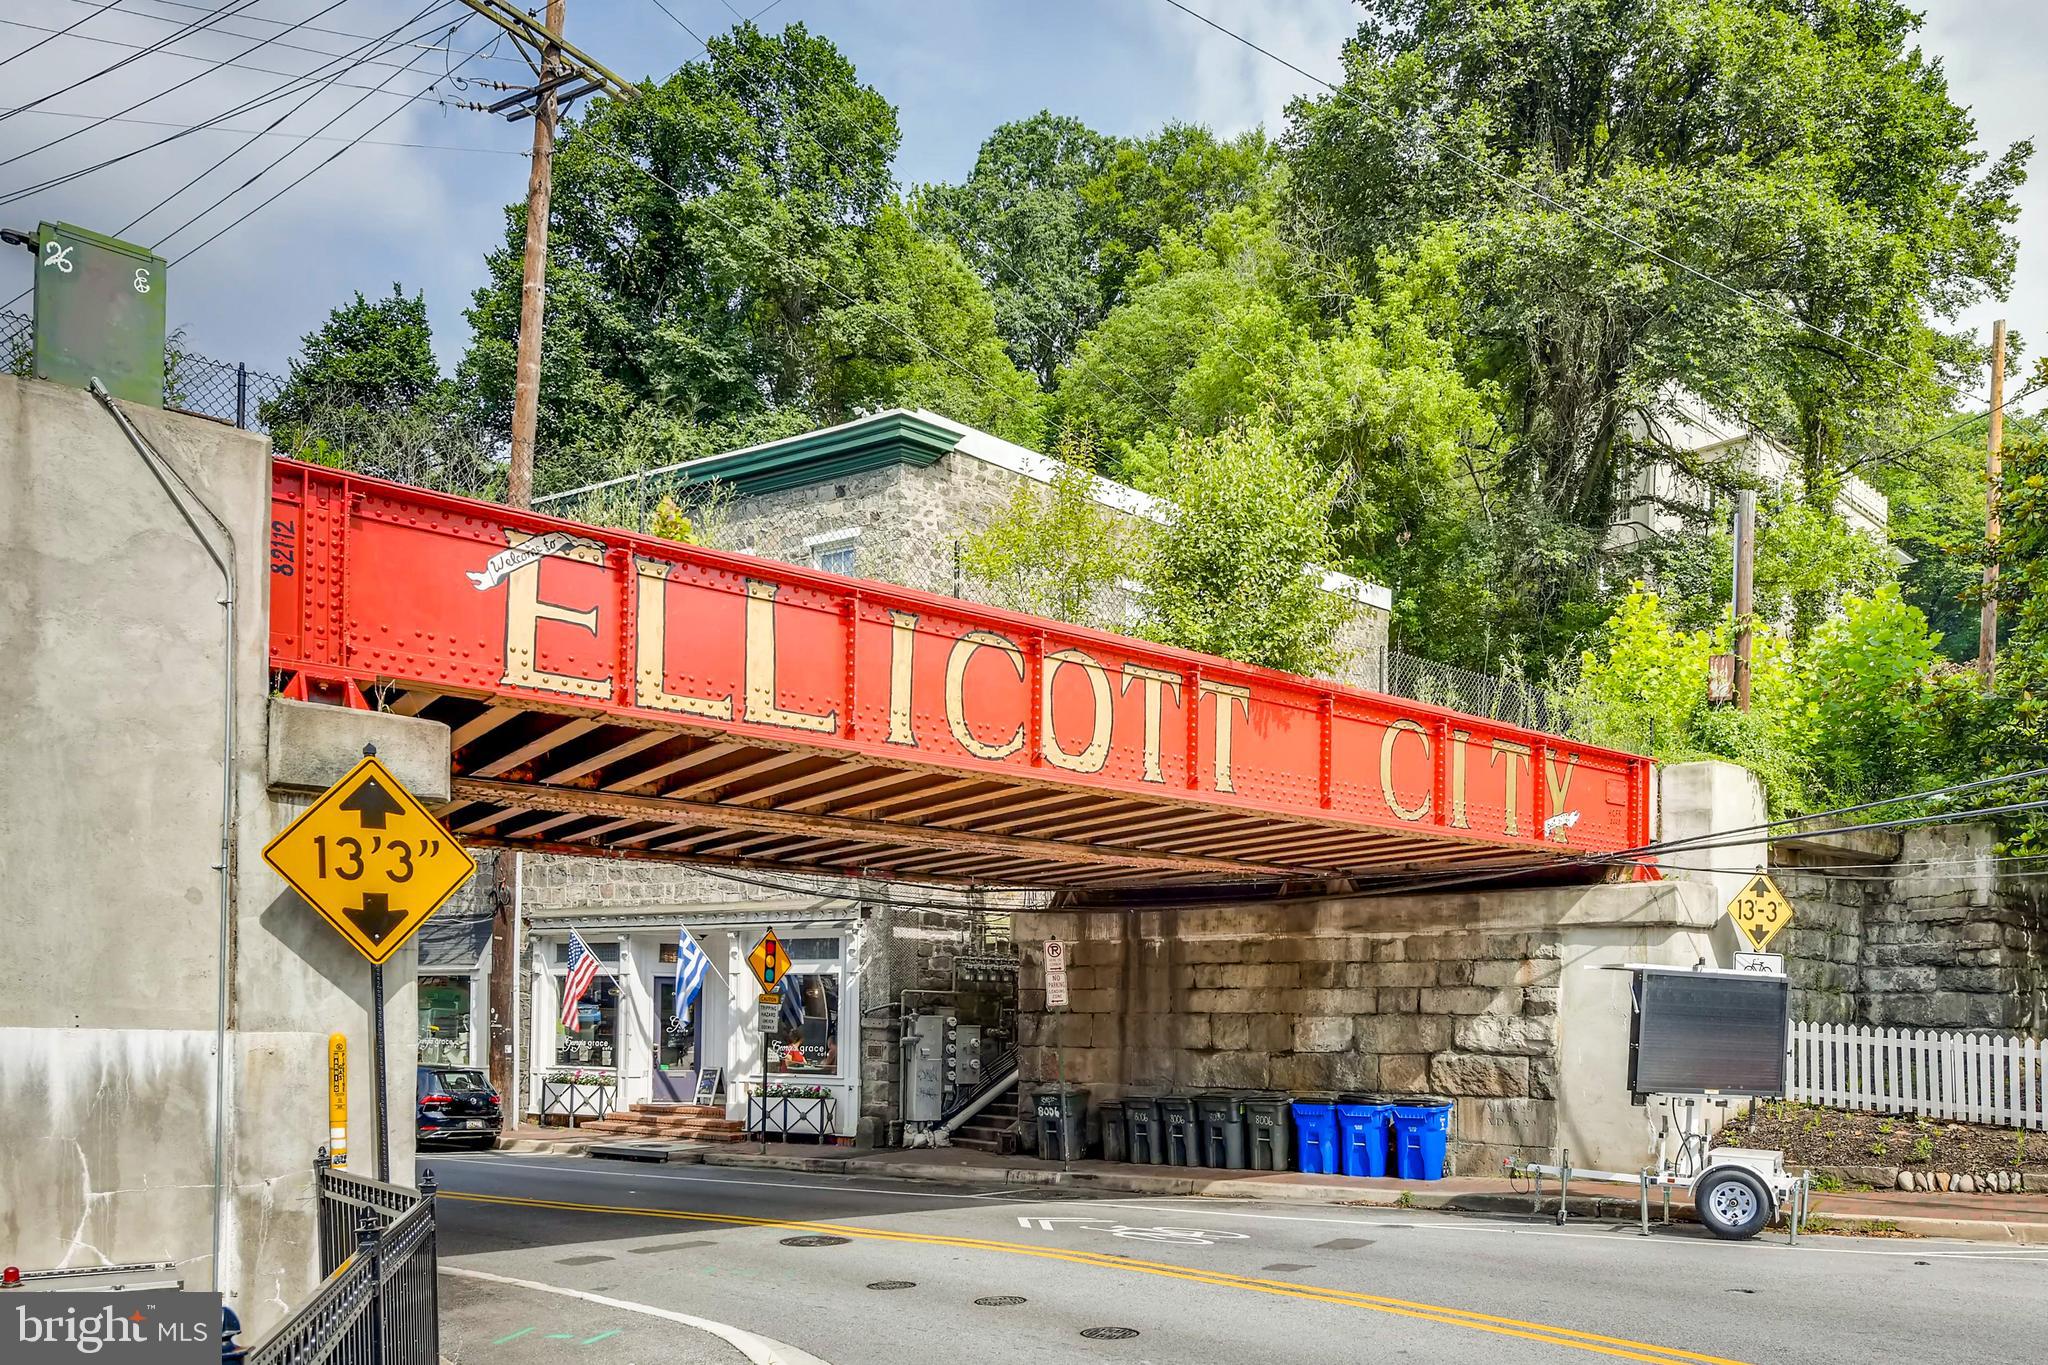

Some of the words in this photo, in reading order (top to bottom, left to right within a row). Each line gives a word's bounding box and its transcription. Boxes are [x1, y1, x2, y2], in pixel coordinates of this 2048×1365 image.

[490, 545, 543, 573] Welcome
[543, 537, 556, 552] to
[499, 527, 1251, 794] ELLICOTT
[1379, 718, 1580, 844] CITY
[587, 1040, 609, 1050] grace
[799, 1045, 825, 1056] grace
[1255, 1115, 1274, 1126] 8006
